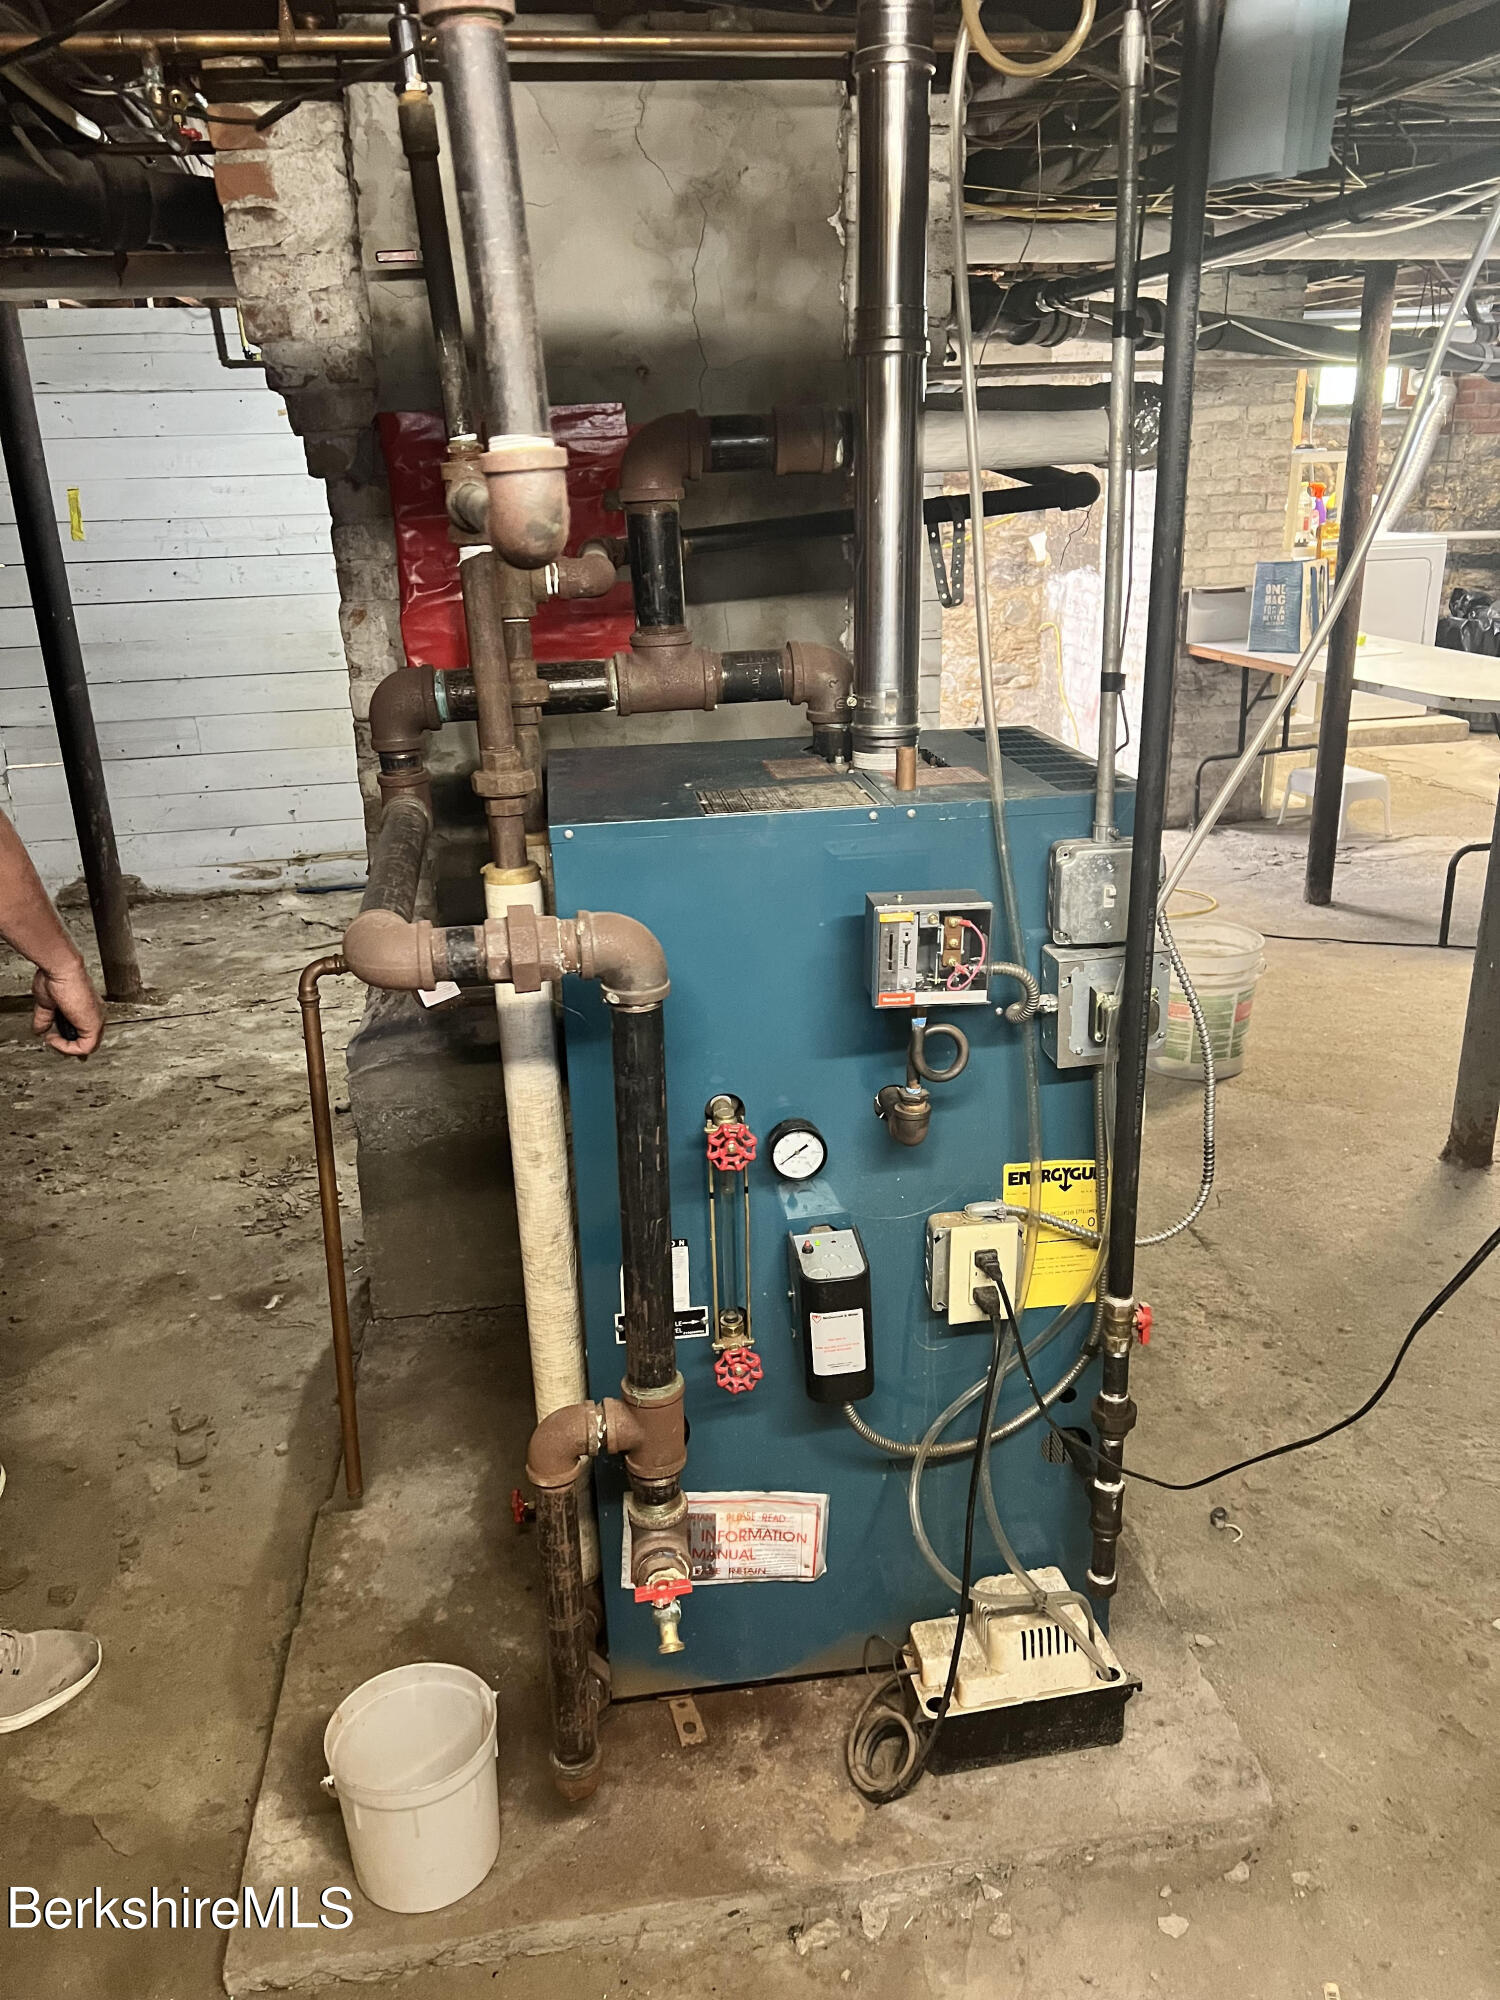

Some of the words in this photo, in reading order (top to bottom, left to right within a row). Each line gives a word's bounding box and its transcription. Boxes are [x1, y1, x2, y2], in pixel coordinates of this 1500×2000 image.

[1265, 584, 1286, 594] ONE
[1265, 595, 1286, 605] BAG
[761, 1513, 786, 1523] READ
[701, 1528, 808, 1544] INFORMATION
[692, 1548, 757, 1560] MANUAL
[728, 1567, 767, 1575] RETAIN
